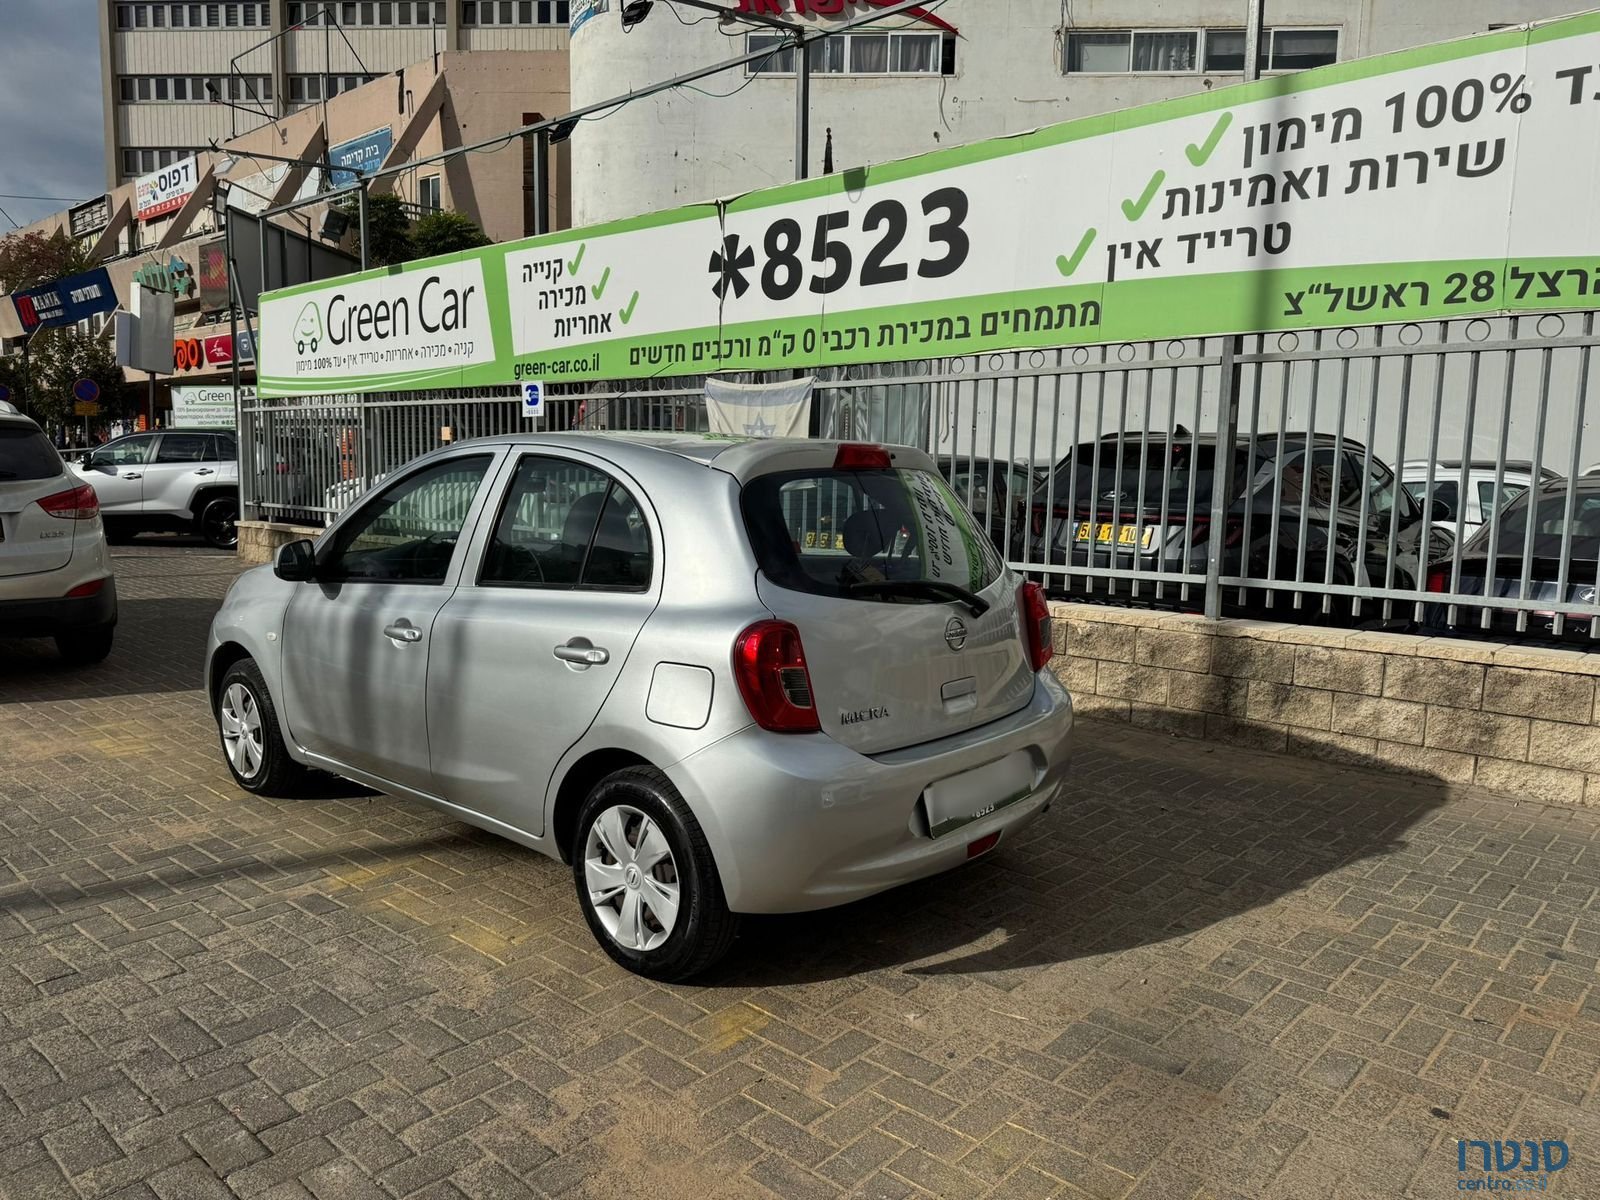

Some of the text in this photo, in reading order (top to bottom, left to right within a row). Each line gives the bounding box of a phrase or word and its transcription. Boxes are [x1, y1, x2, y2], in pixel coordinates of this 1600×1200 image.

[1385, 72, 1532, 134] 100%
[1243, 107, 1362, 168] מימון
[365, 144, 380, 158] בית
[159, 164, 189, 192] דפוס
[1162, 137, 1506, 220] שירות ואמינות
[1106, 221, 1291, 282] טרייד אין
[522, 258, 563, 284] קנייה
[538, 285, 586, 310] מכירה
[1443, 271, 1496, 304] 28
[327, 276, 474, 345] Green Car
[981, 300, 1100, 337] מתמחים
[554, 313, 612, 338] אחריות
[877, 316, 971, 347] במכירת
[420, 344, 446, 358] מכירה
[454, 341, 473, 358] קניה
[692, 338, 750, 361] ורכבים
[803, 328, 815, 353] 0
[823, 327, 869, 352] רכבי
[314, 357, 332, 370] 100%
[385, 347, 414, 362] אחריות
[514, 353, 600, 379] green-car.co.il
[630, 344, 686, 366] חדשים
[199, 389, 231, 401] Green
[841, 706, 889, 725] MICRA
